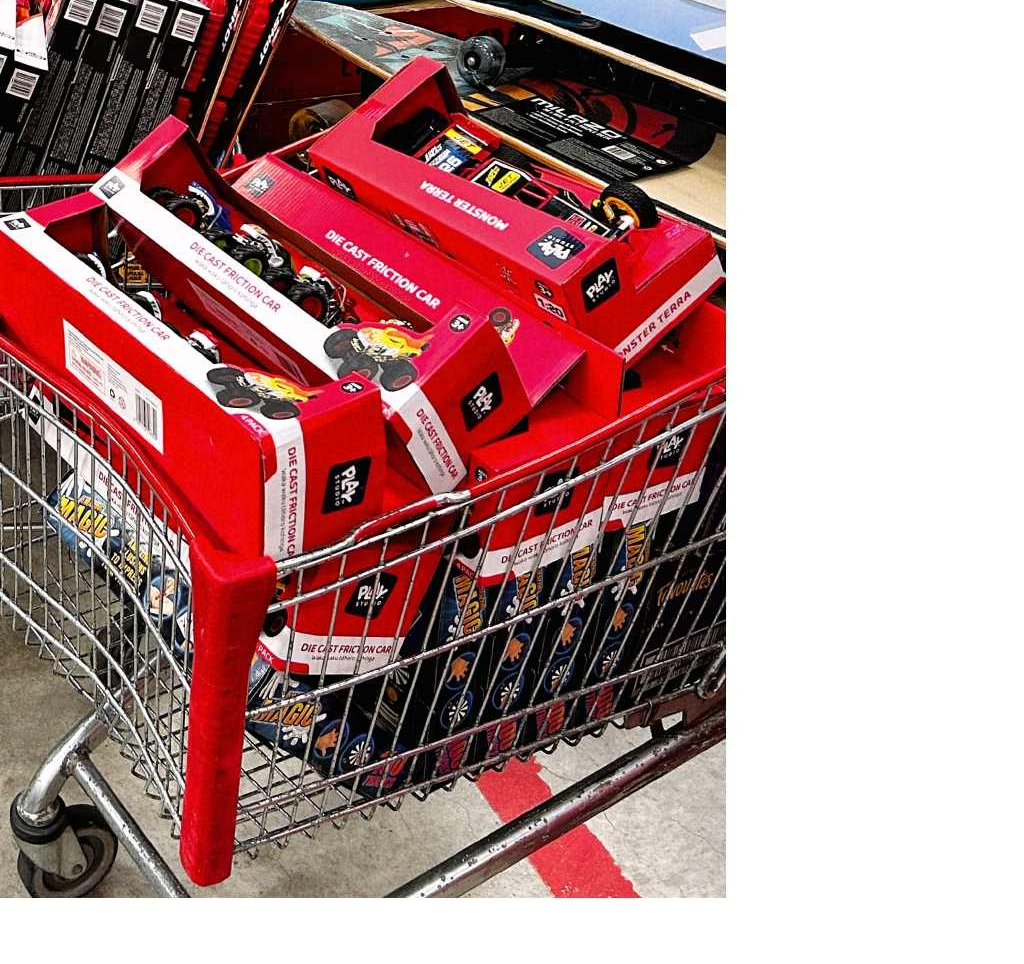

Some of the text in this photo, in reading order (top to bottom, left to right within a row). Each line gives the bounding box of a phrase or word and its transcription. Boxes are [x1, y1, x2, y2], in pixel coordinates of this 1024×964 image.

[530, 97, 623, 139] MILAZO
[420, 180, 510, 231] MONSTER TERRA
[325, 229, 441, 310] DIE CAST FRICTION CAR
[538, 240, 571, 260] PLAY
[190, 241, 282, 313] DIE CAST FRICTION CAR
[585, 269, 615, 299] PLAY
[86, 276, 171, 341] DIE CAST FRICTION CAR
[657, 290, 691, 323] TERRA
[473, 386, 493, 412] PLAY
[247, 418, 266, 435] PACK
[416, 408, 429, 424] DIE
[424, 419, 438, 442] CAST
[433, 435, 453, 468] FRICTION
[448, 461, 458, 479] CAR
[287, 446, 298, 558] DIE CAST FRICTION CA
[341, 464, 360, 503] PLAY
[517, 543, 538, 558] CAST
[301, 643, 317, 653] DIE
[339, 644, 375, 654] FRICTON
[375, 645, 393, 654] CAR
